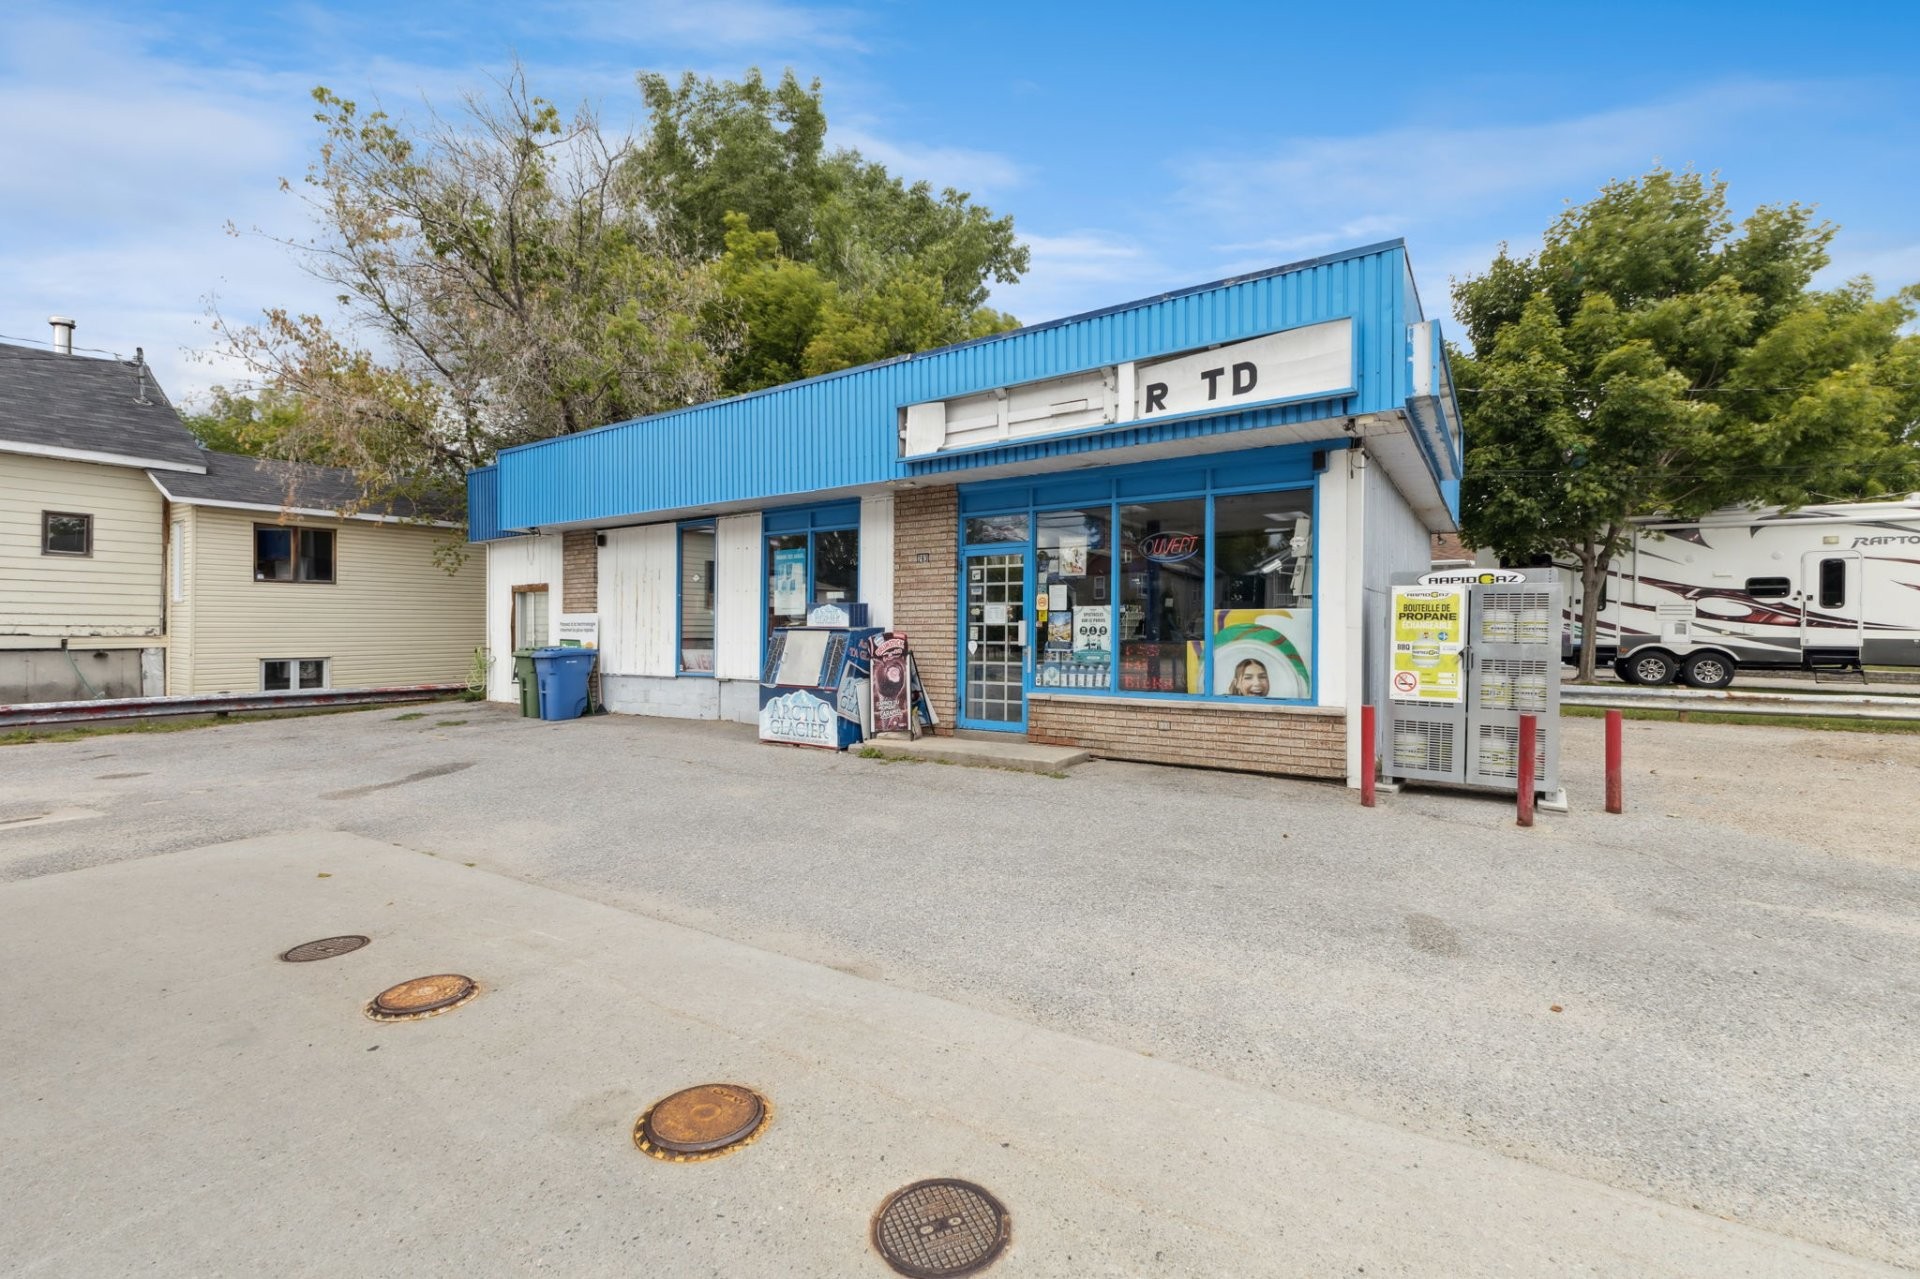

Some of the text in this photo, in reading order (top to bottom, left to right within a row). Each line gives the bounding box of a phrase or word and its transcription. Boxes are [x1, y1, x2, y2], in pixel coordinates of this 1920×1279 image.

[1145, 382, 1169, 413] R
[1144, 536, 1199, 555] OUVERT
[1851, 535, 1920, 549] RAPTO
[1428, 573, 1519, 585] RAPIDGAZ
[1403, 604, 1451, 612] BOUTEILLE DE
[1399, 612, 1457, 621] PROPANE
[1397, 643, 1410, 651] BBQ
[769, 699, 830, 724] ARCTIC
[769, 719, 830, 740] GLACIER
